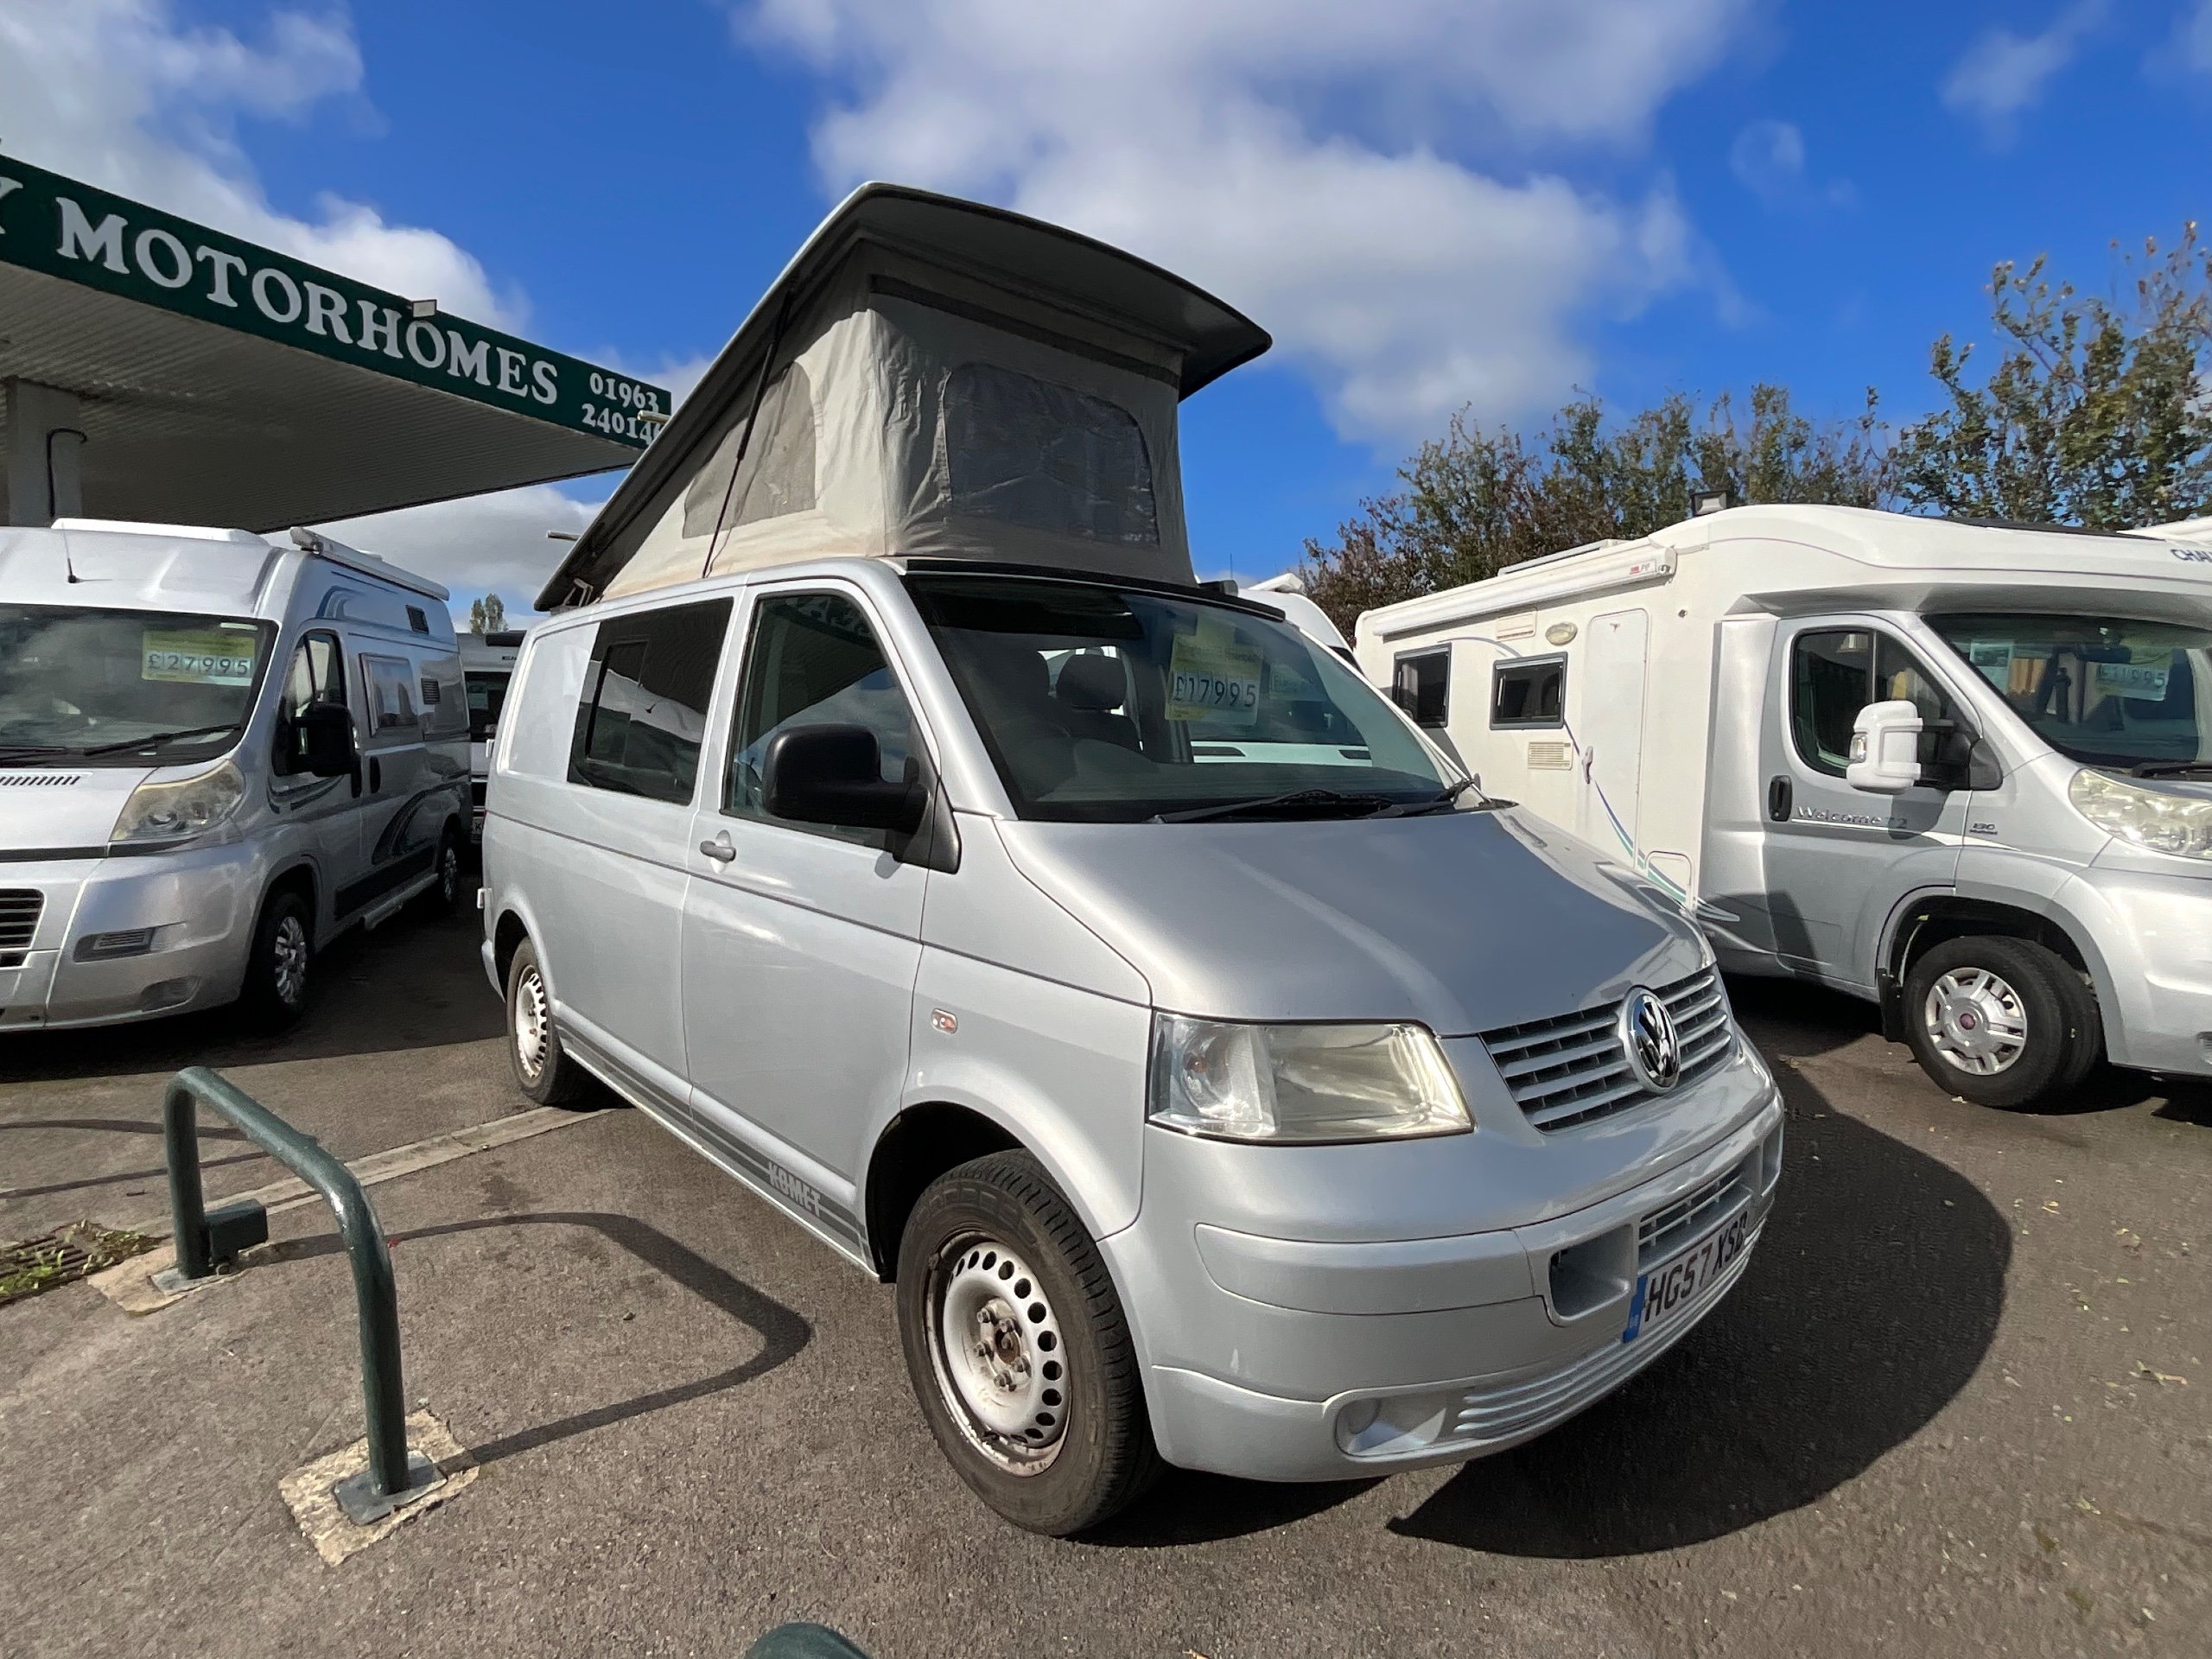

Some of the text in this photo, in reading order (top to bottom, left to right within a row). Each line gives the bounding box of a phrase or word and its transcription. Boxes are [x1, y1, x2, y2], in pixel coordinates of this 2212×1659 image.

[55, 196, 558, 405] MOTORHOMES
[589, 372, 659, 414] 01963
[147, 653, 249, 676] £27995
[1173, 676, 1256, 708] £17995
[1796, 806, 1883, 824] Welcome
[1644, 1242, 1713, 1322] HG57
